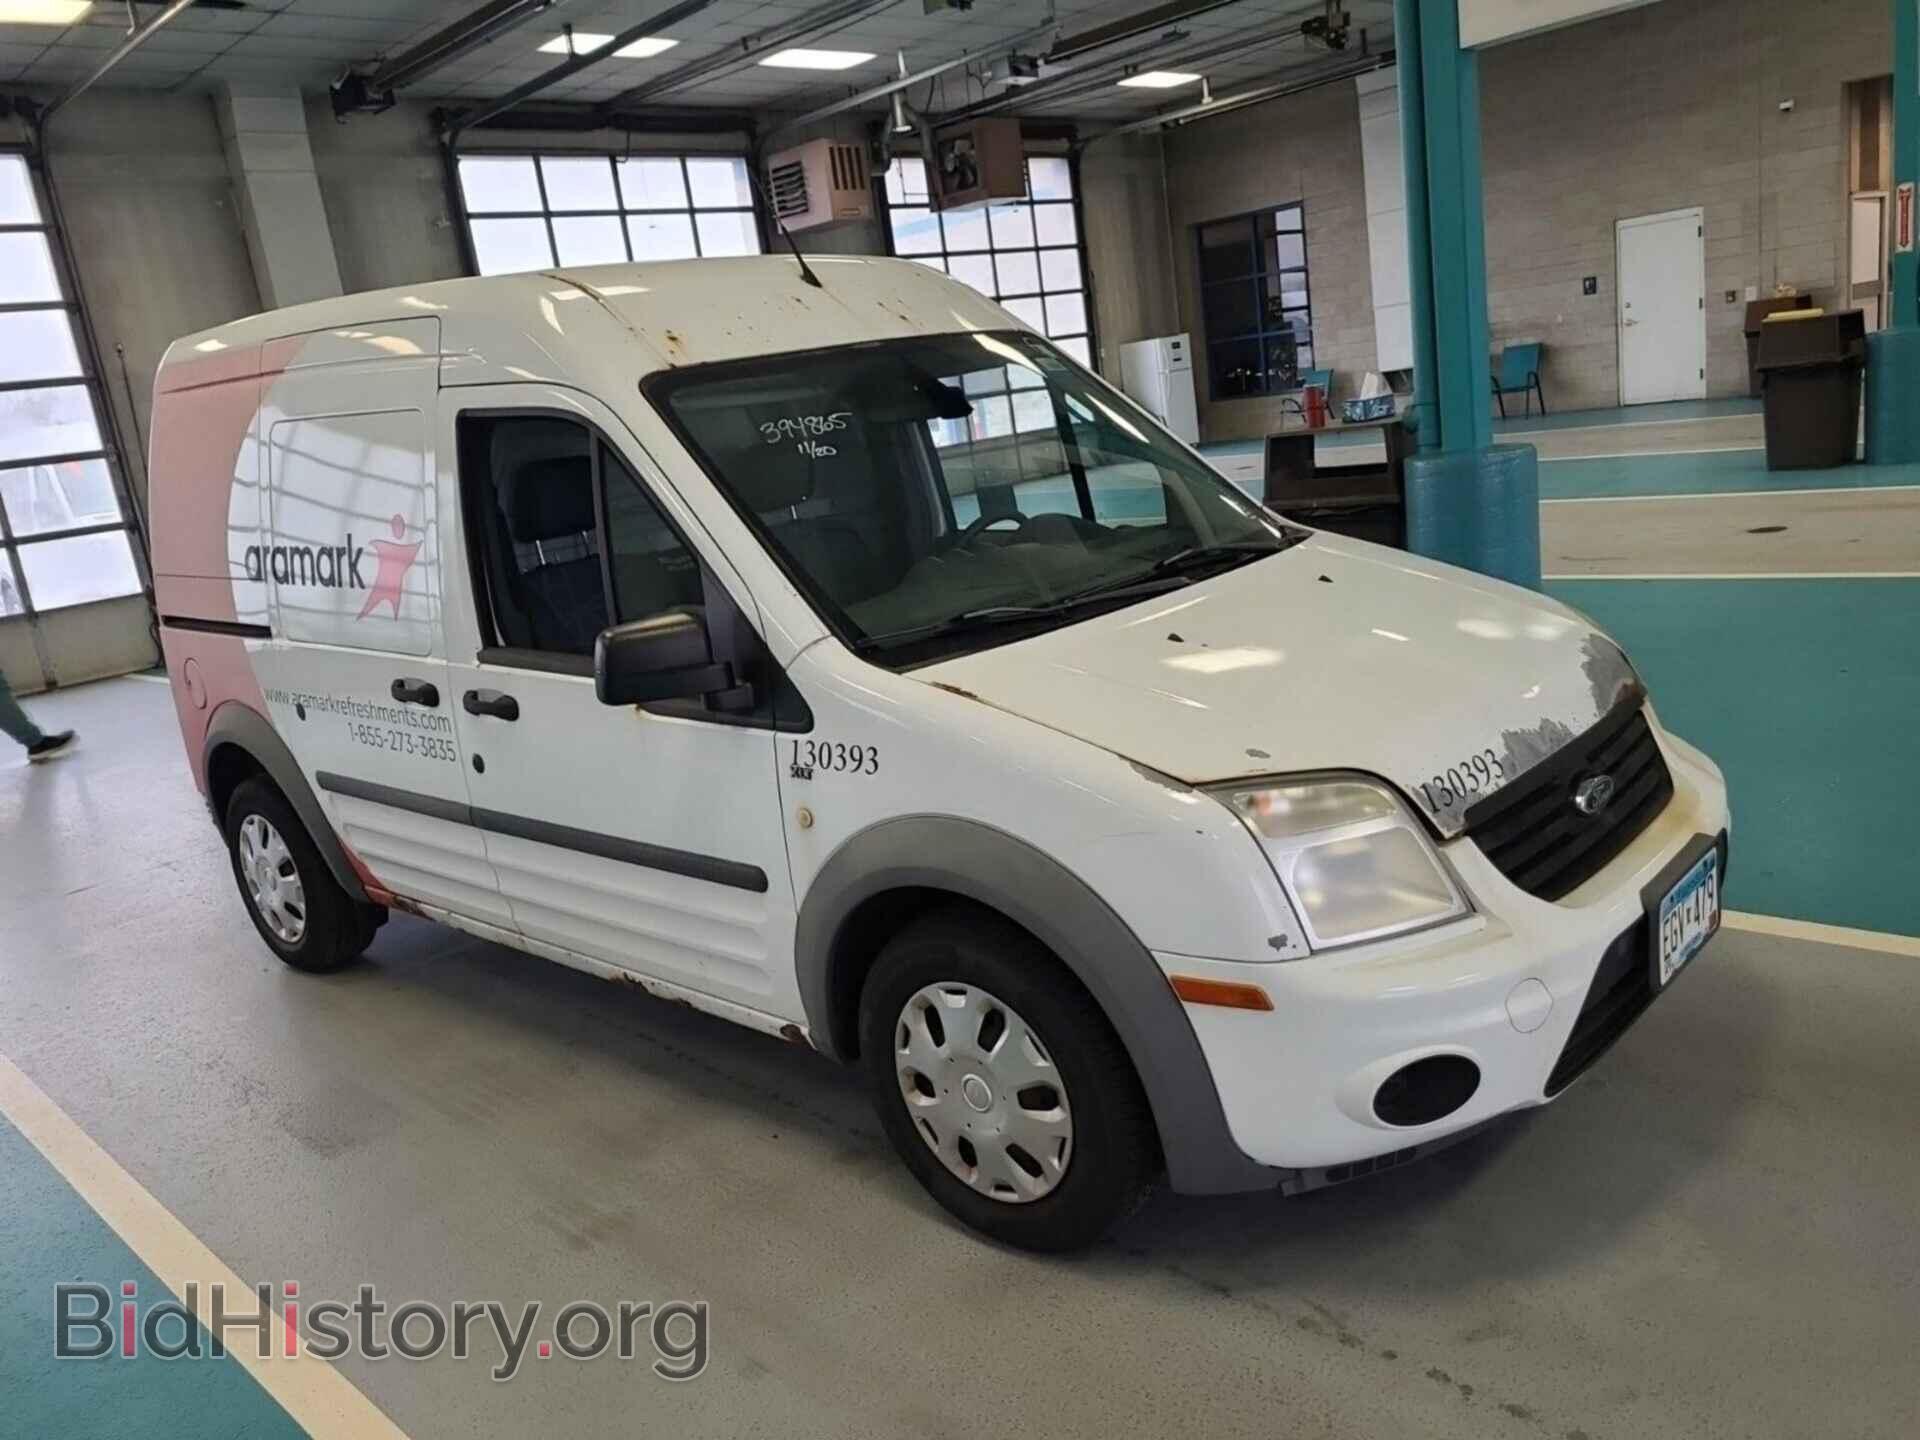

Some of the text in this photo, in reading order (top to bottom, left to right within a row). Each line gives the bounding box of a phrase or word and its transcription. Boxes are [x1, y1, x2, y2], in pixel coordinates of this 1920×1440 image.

[244, 533, 366, 590] aramark
[265, 688, 452, 734] www.aramarkrefreshments.com
[348, 722, 456, 762] 1-855-273-3835
[791, 739, 879, 775] 130393
[1419, 749, 1505, 814] 130393
